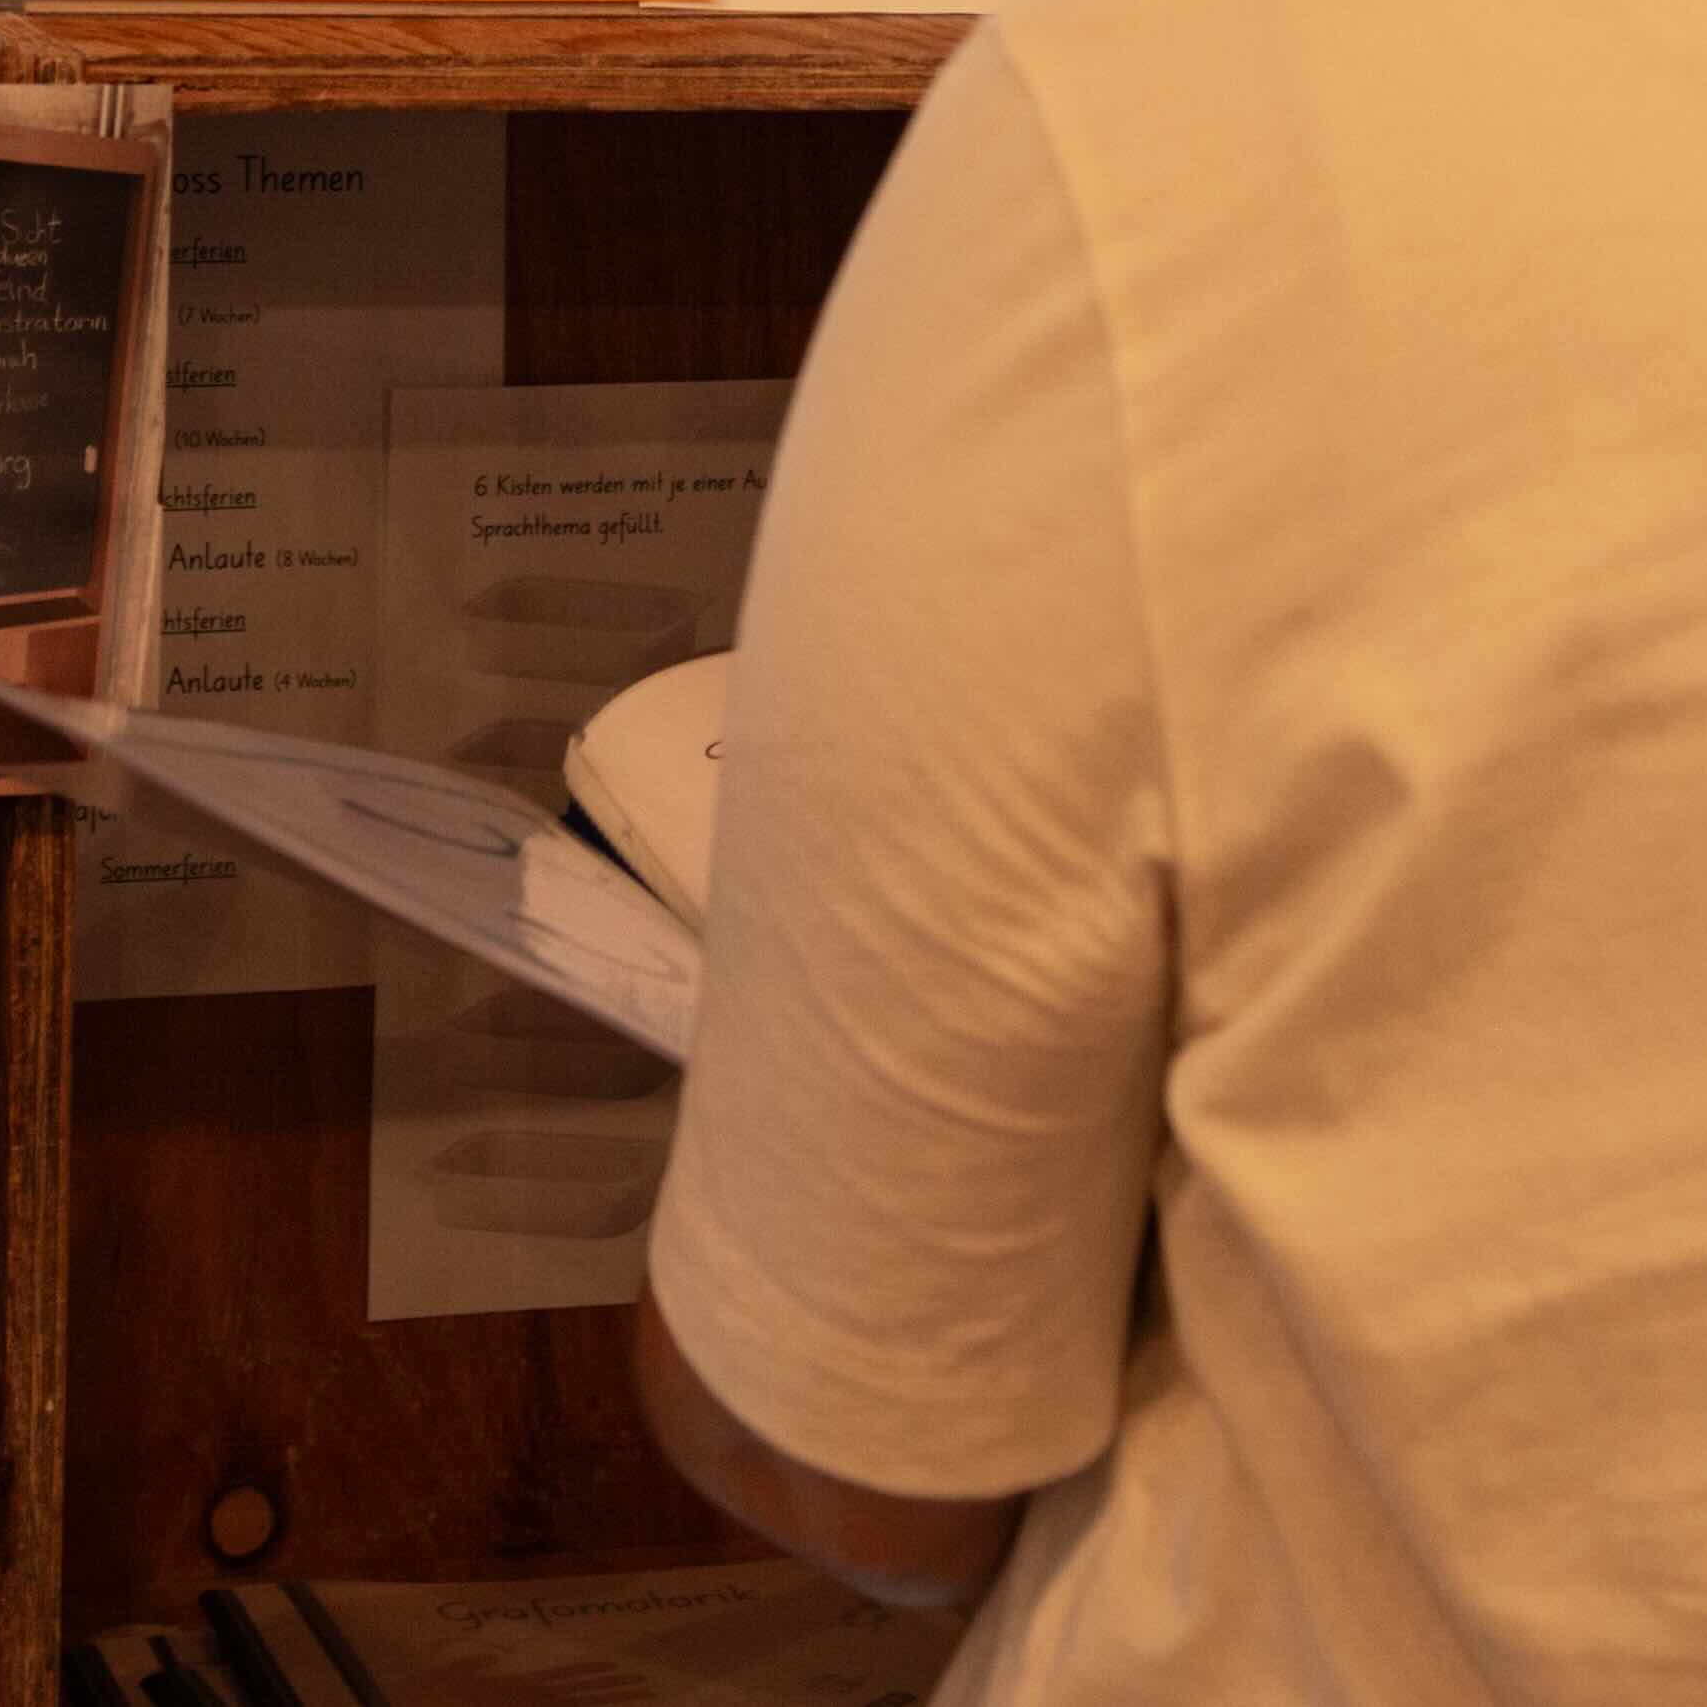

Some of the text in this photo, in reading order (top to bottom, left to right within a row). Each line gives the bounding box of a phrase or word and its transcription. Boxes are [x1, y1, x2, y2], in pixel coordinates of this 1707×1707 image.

[236, 154, 365, 193] Themen
[201, 428, 266, 449] Wochen)
[473, 475, 487, 496] 6
[497, 474, 552, 496] Kisten
[559, 475, 622, 496] werden
[631, 470, 664, 493] mit
[669, 472, 689, 502] je
[693, 473, 735, 492] einer
[470, 514, 591, 547] Sprachthema
[168, 540, 266, 571] Anlaute
[297, 547, 359, 569] Wochen)
[166, 663, 264, 694] Anlaute
[295, 669, 357, 691] Wochen)
[100, 853, 238, 885] Sommerferien
[436, 1578, 757, 1632] Grafomotorik
